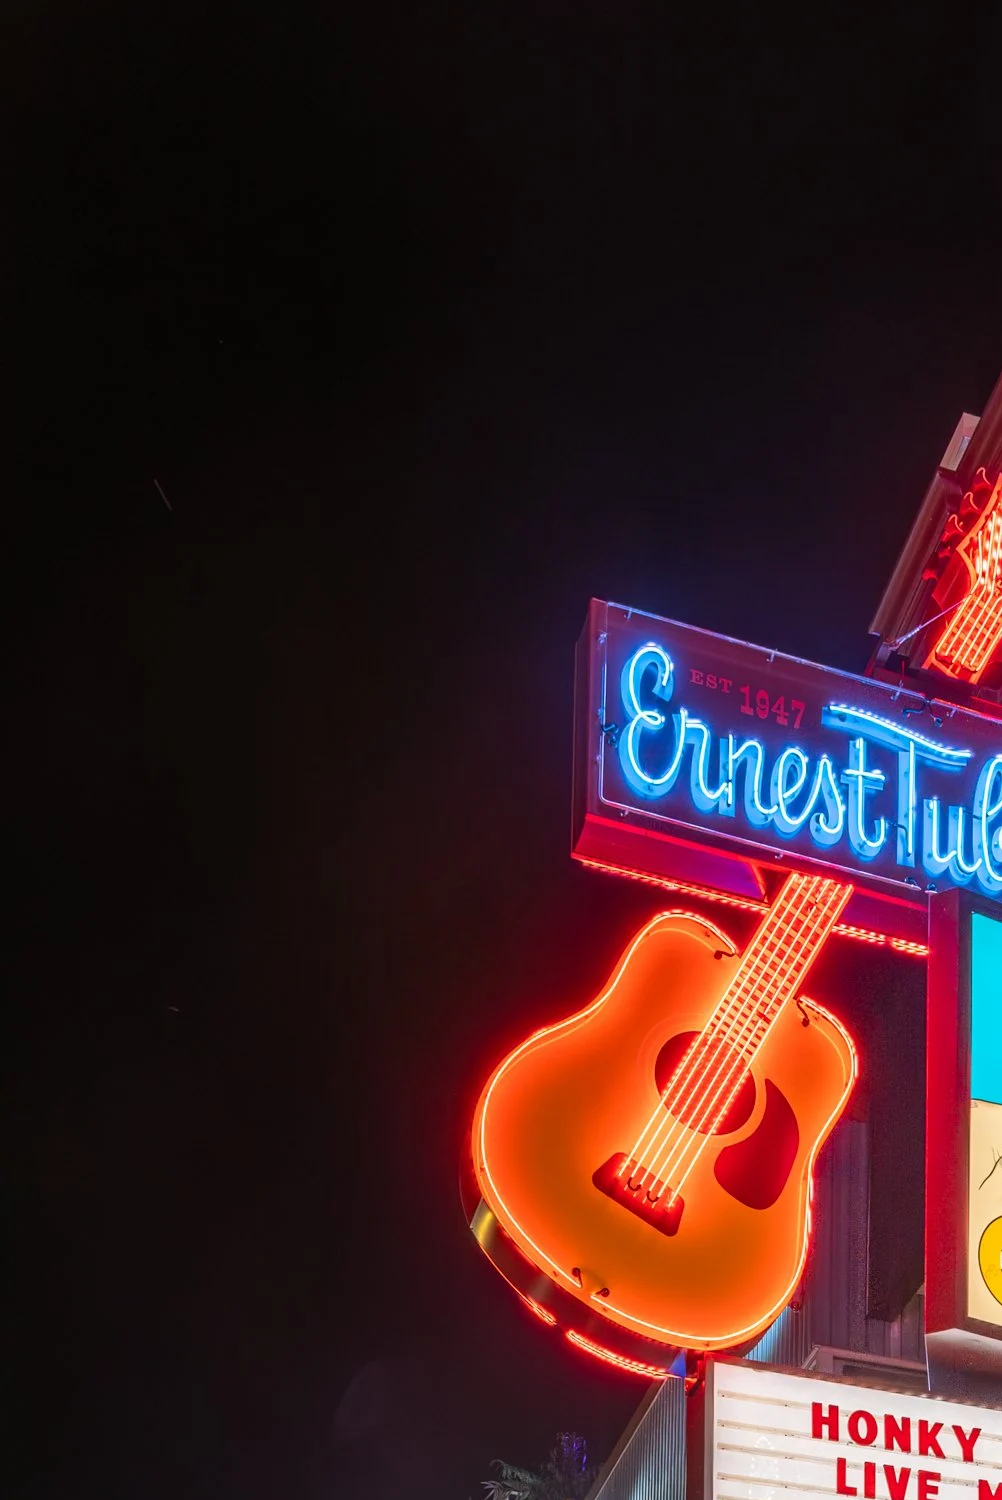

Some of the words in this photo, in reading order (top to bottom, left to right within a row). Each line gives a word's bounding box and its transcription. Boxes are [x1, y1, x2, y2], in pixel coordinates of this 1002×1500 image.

[689, 668, 731, 693] EST
[739, 684, 806, 729] 1947
[620, 642, 886, 861] Ernest
[811, 1402, 982, 1463] HONKY
